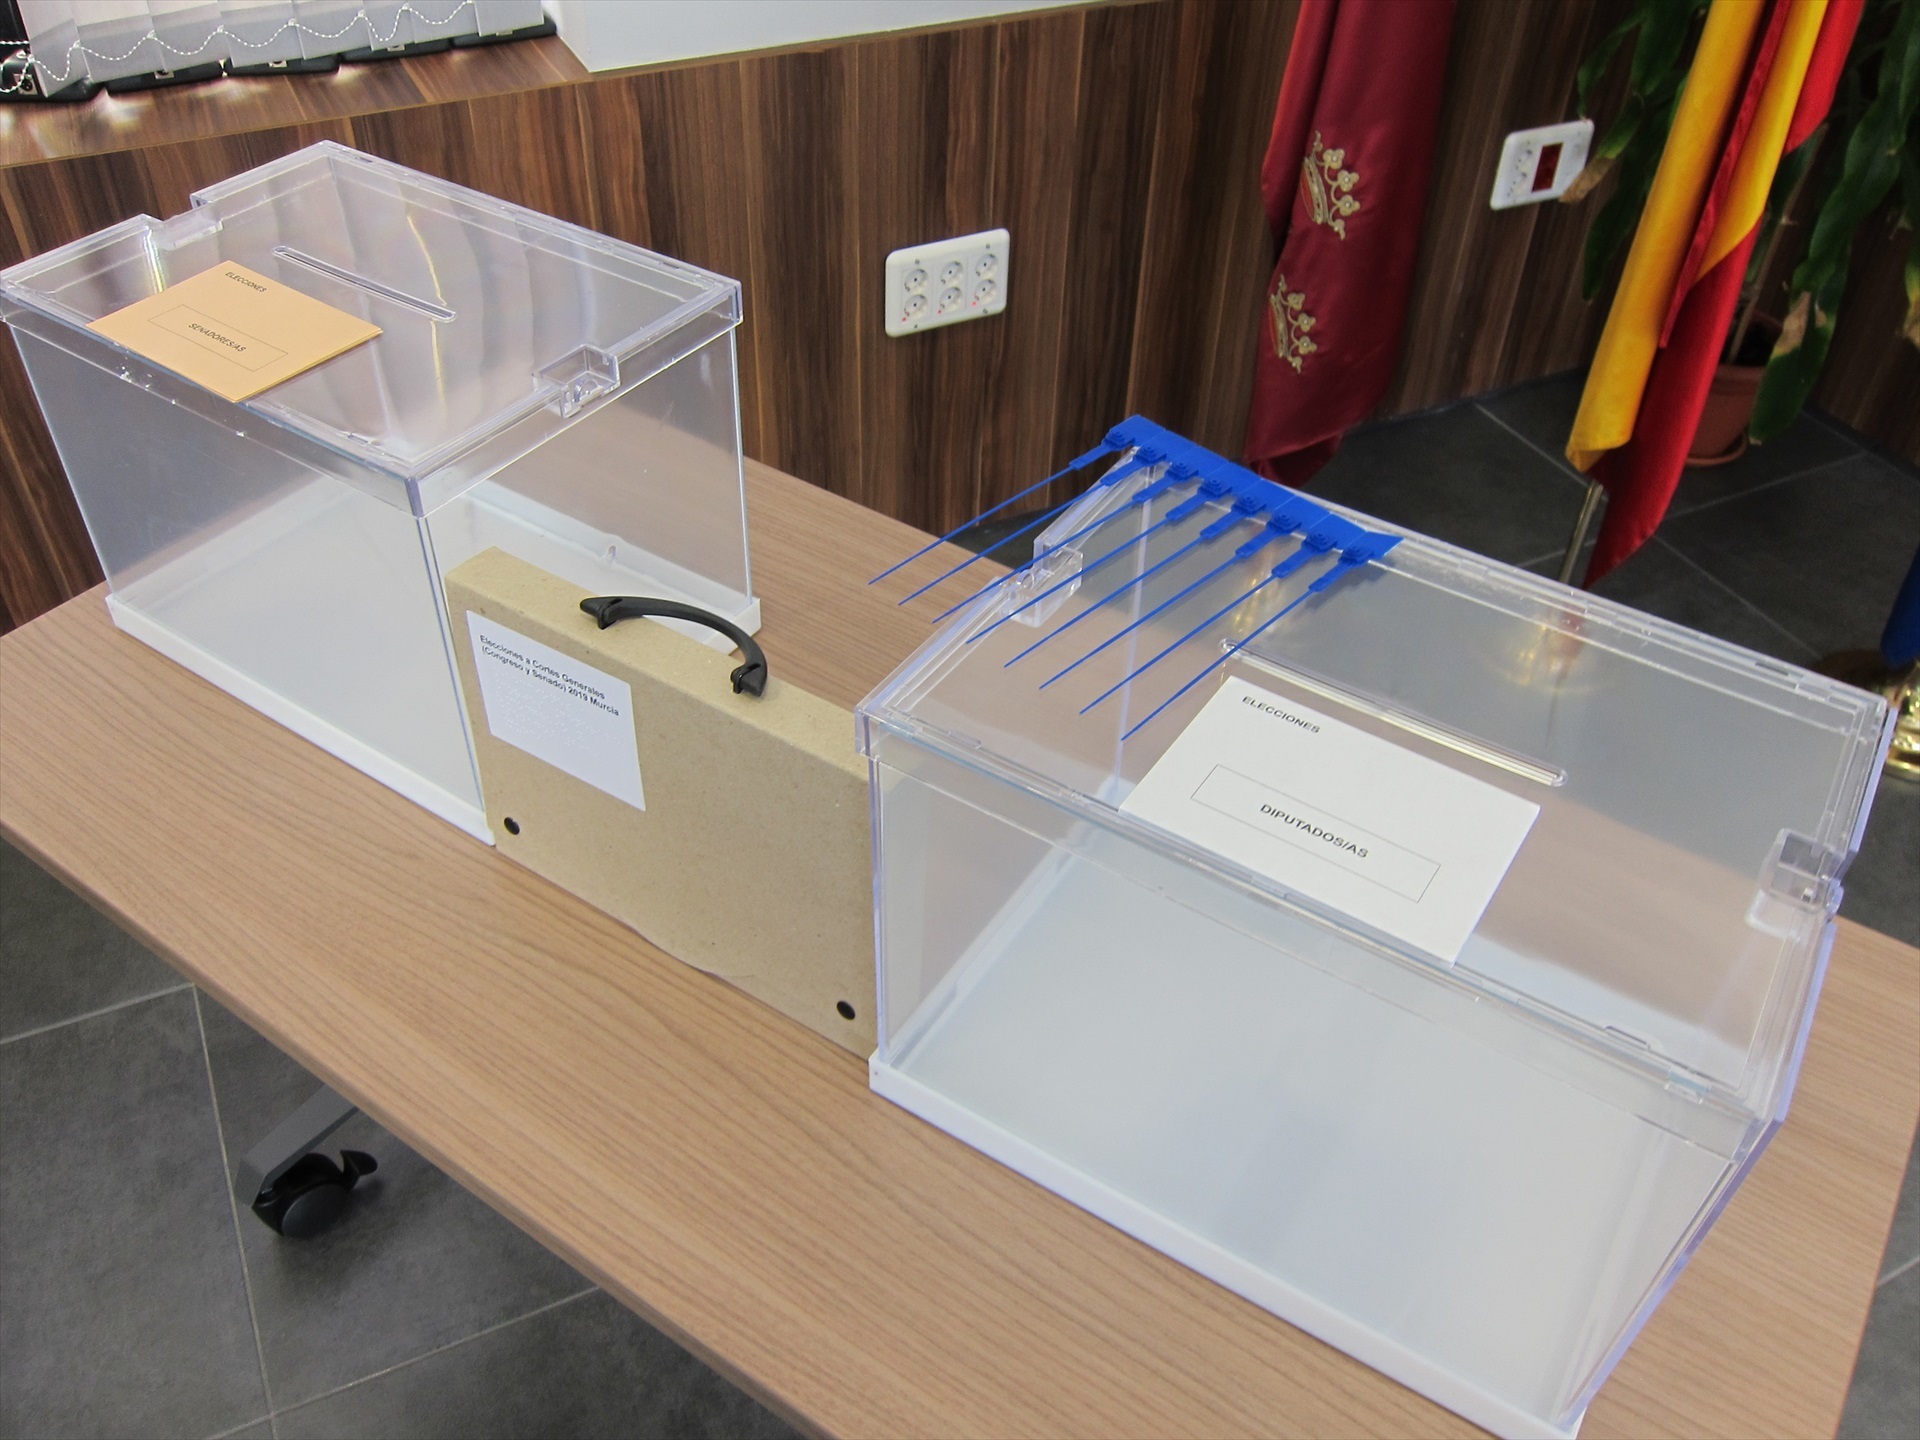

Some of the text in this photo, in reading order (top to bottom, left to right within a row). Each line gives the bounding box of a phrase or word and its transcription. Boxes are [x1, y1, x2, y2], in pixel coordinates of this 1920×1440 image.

[225, 271, 267, 293] ELECCIONES
[188, 322, 247, 352] SENADORES/AS
[480, 635, 524, 662] Elecciones
[532, 660, 560, 679] Cortes
[561, 673, 606, 700] Generales
[482, 645, 524, 671] (Congreso
[532, 669, 567, 693] Senado)
[567, 686, 588, 702] 2019
[590, 696, 619, 716] Murcia
[1242, 695, 1320, 734] ELECCIONES
[1259, 803, 1369, 859] DIPUTADOS/AS
